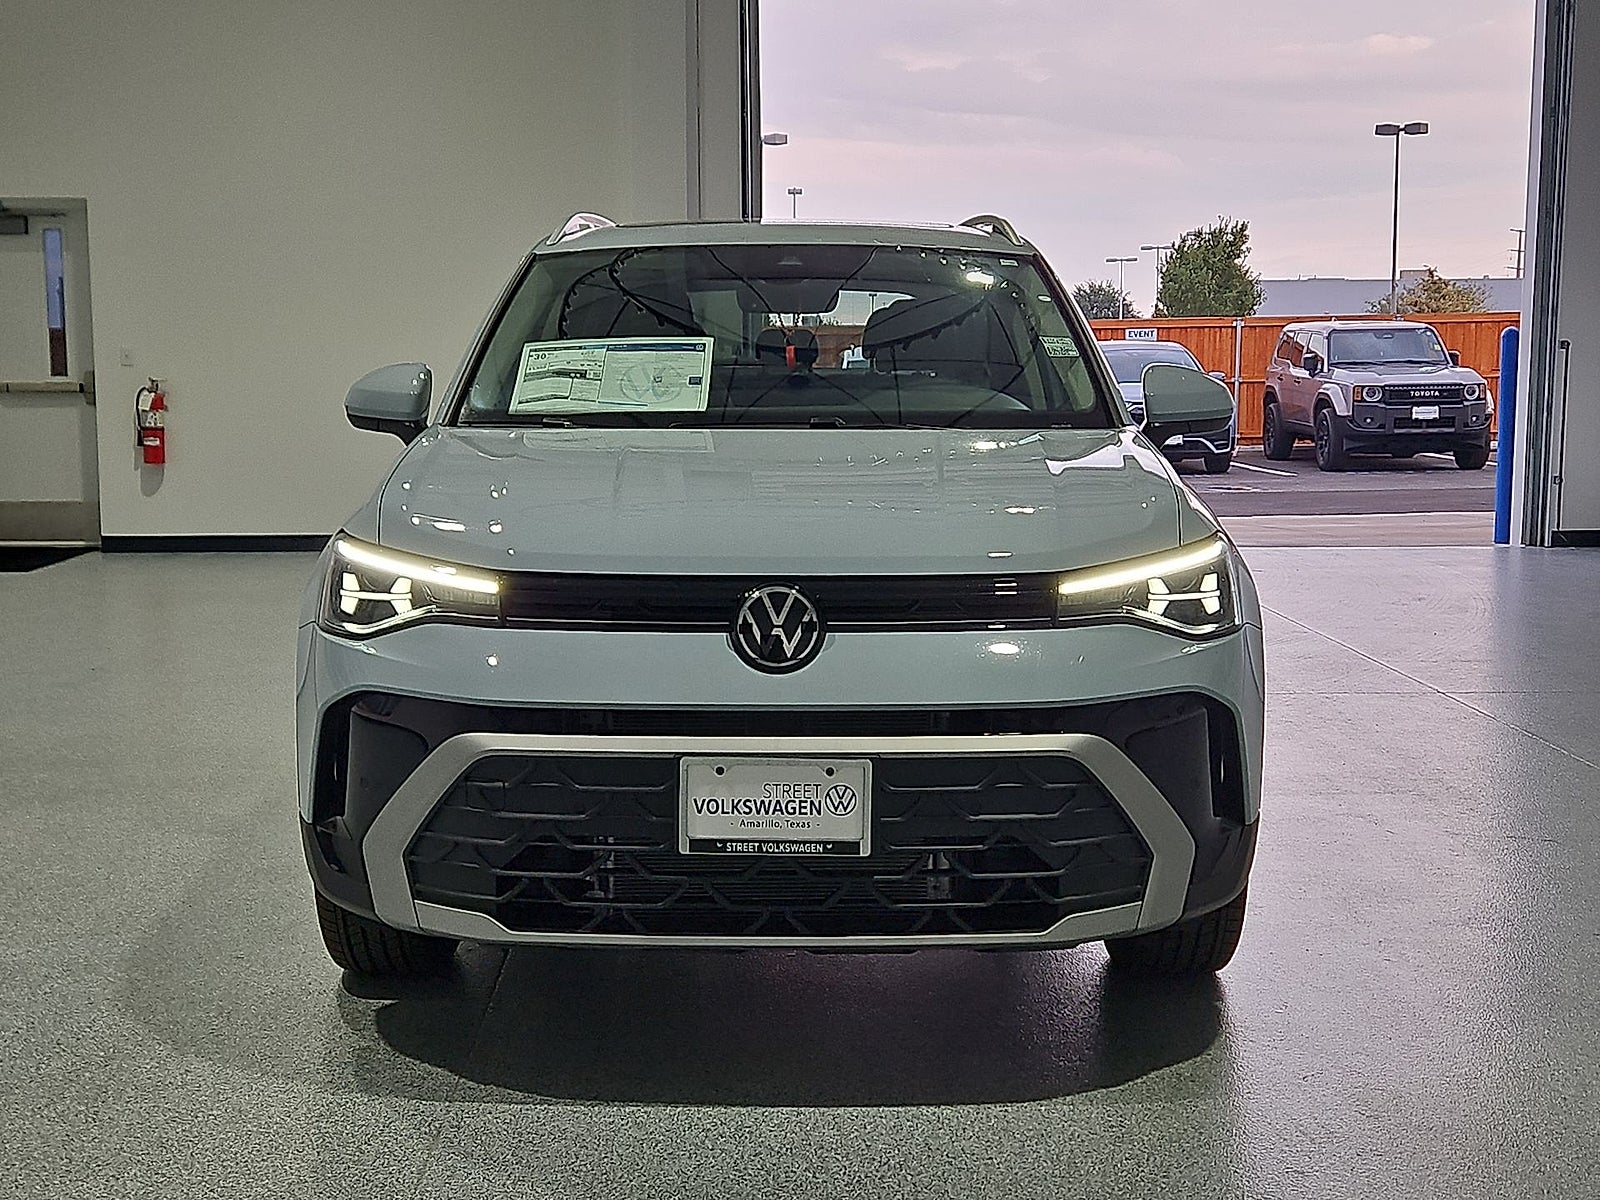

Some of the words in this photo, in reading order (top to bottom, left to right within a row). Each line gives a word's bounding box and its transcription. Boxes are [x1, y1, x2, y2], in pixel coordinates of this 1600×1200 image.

[1127, 330, 1155, 338] EVENT
[762, 783, 822, 799] STREET
[824, 784, 857, 816] VW
[693, 798, 822, 816] VOLKSWAGEN
[739, 819, 783, 829] Amarillo,
[785, 819, 811, 829] Texas
[726, 842, 759, 852] STREET
[761, 842, 824, 853] VOLKSWAGEN
